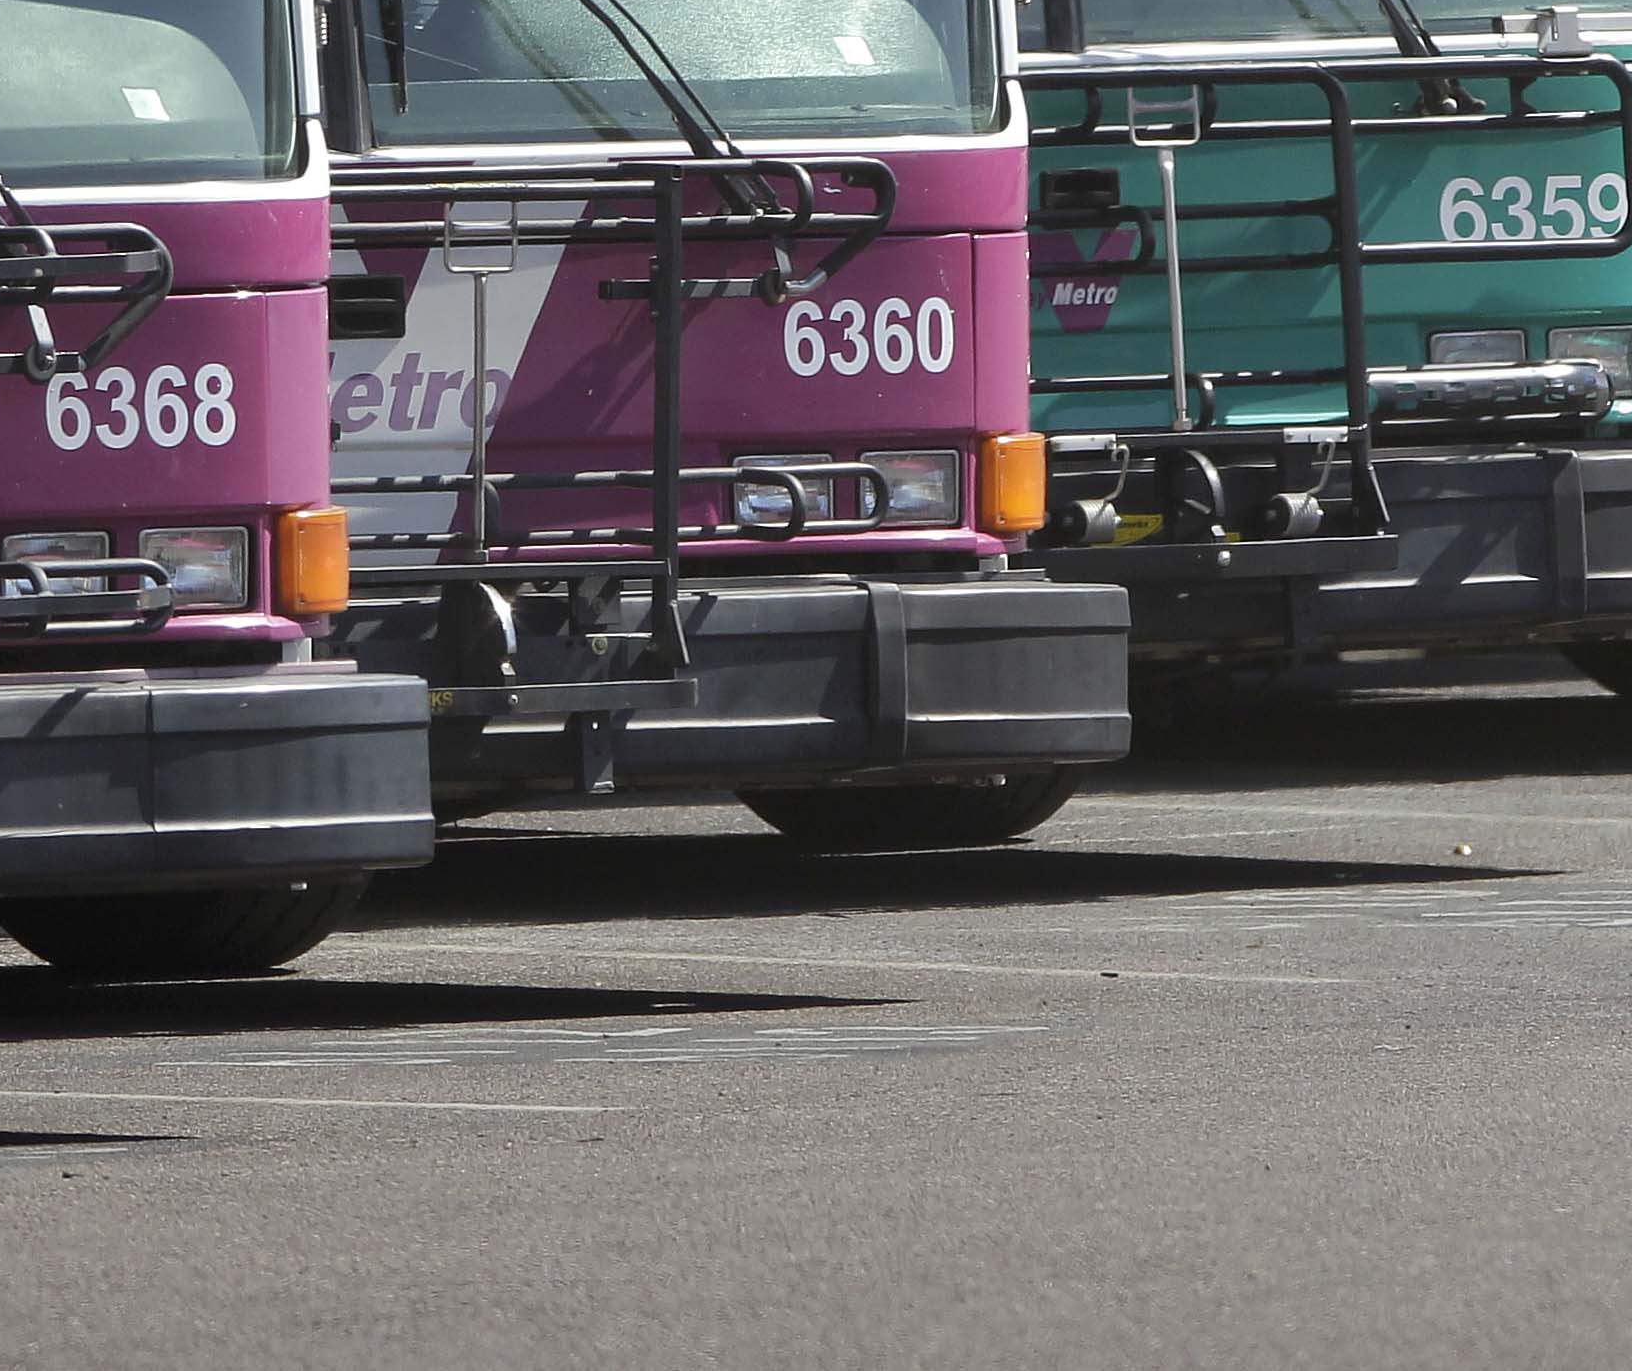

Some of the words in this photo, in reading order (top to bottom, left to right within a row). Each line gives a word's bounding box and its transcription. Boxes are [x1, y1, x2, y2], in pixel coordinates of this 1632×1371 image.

[1439, 172, 1629, 242] 6359
[1052, 282, 1119, 306] Metro
[783, 296, 955, 377] 6360
[45, 362, 237, 451] 6368
[328, 351, 513, 433] etro
